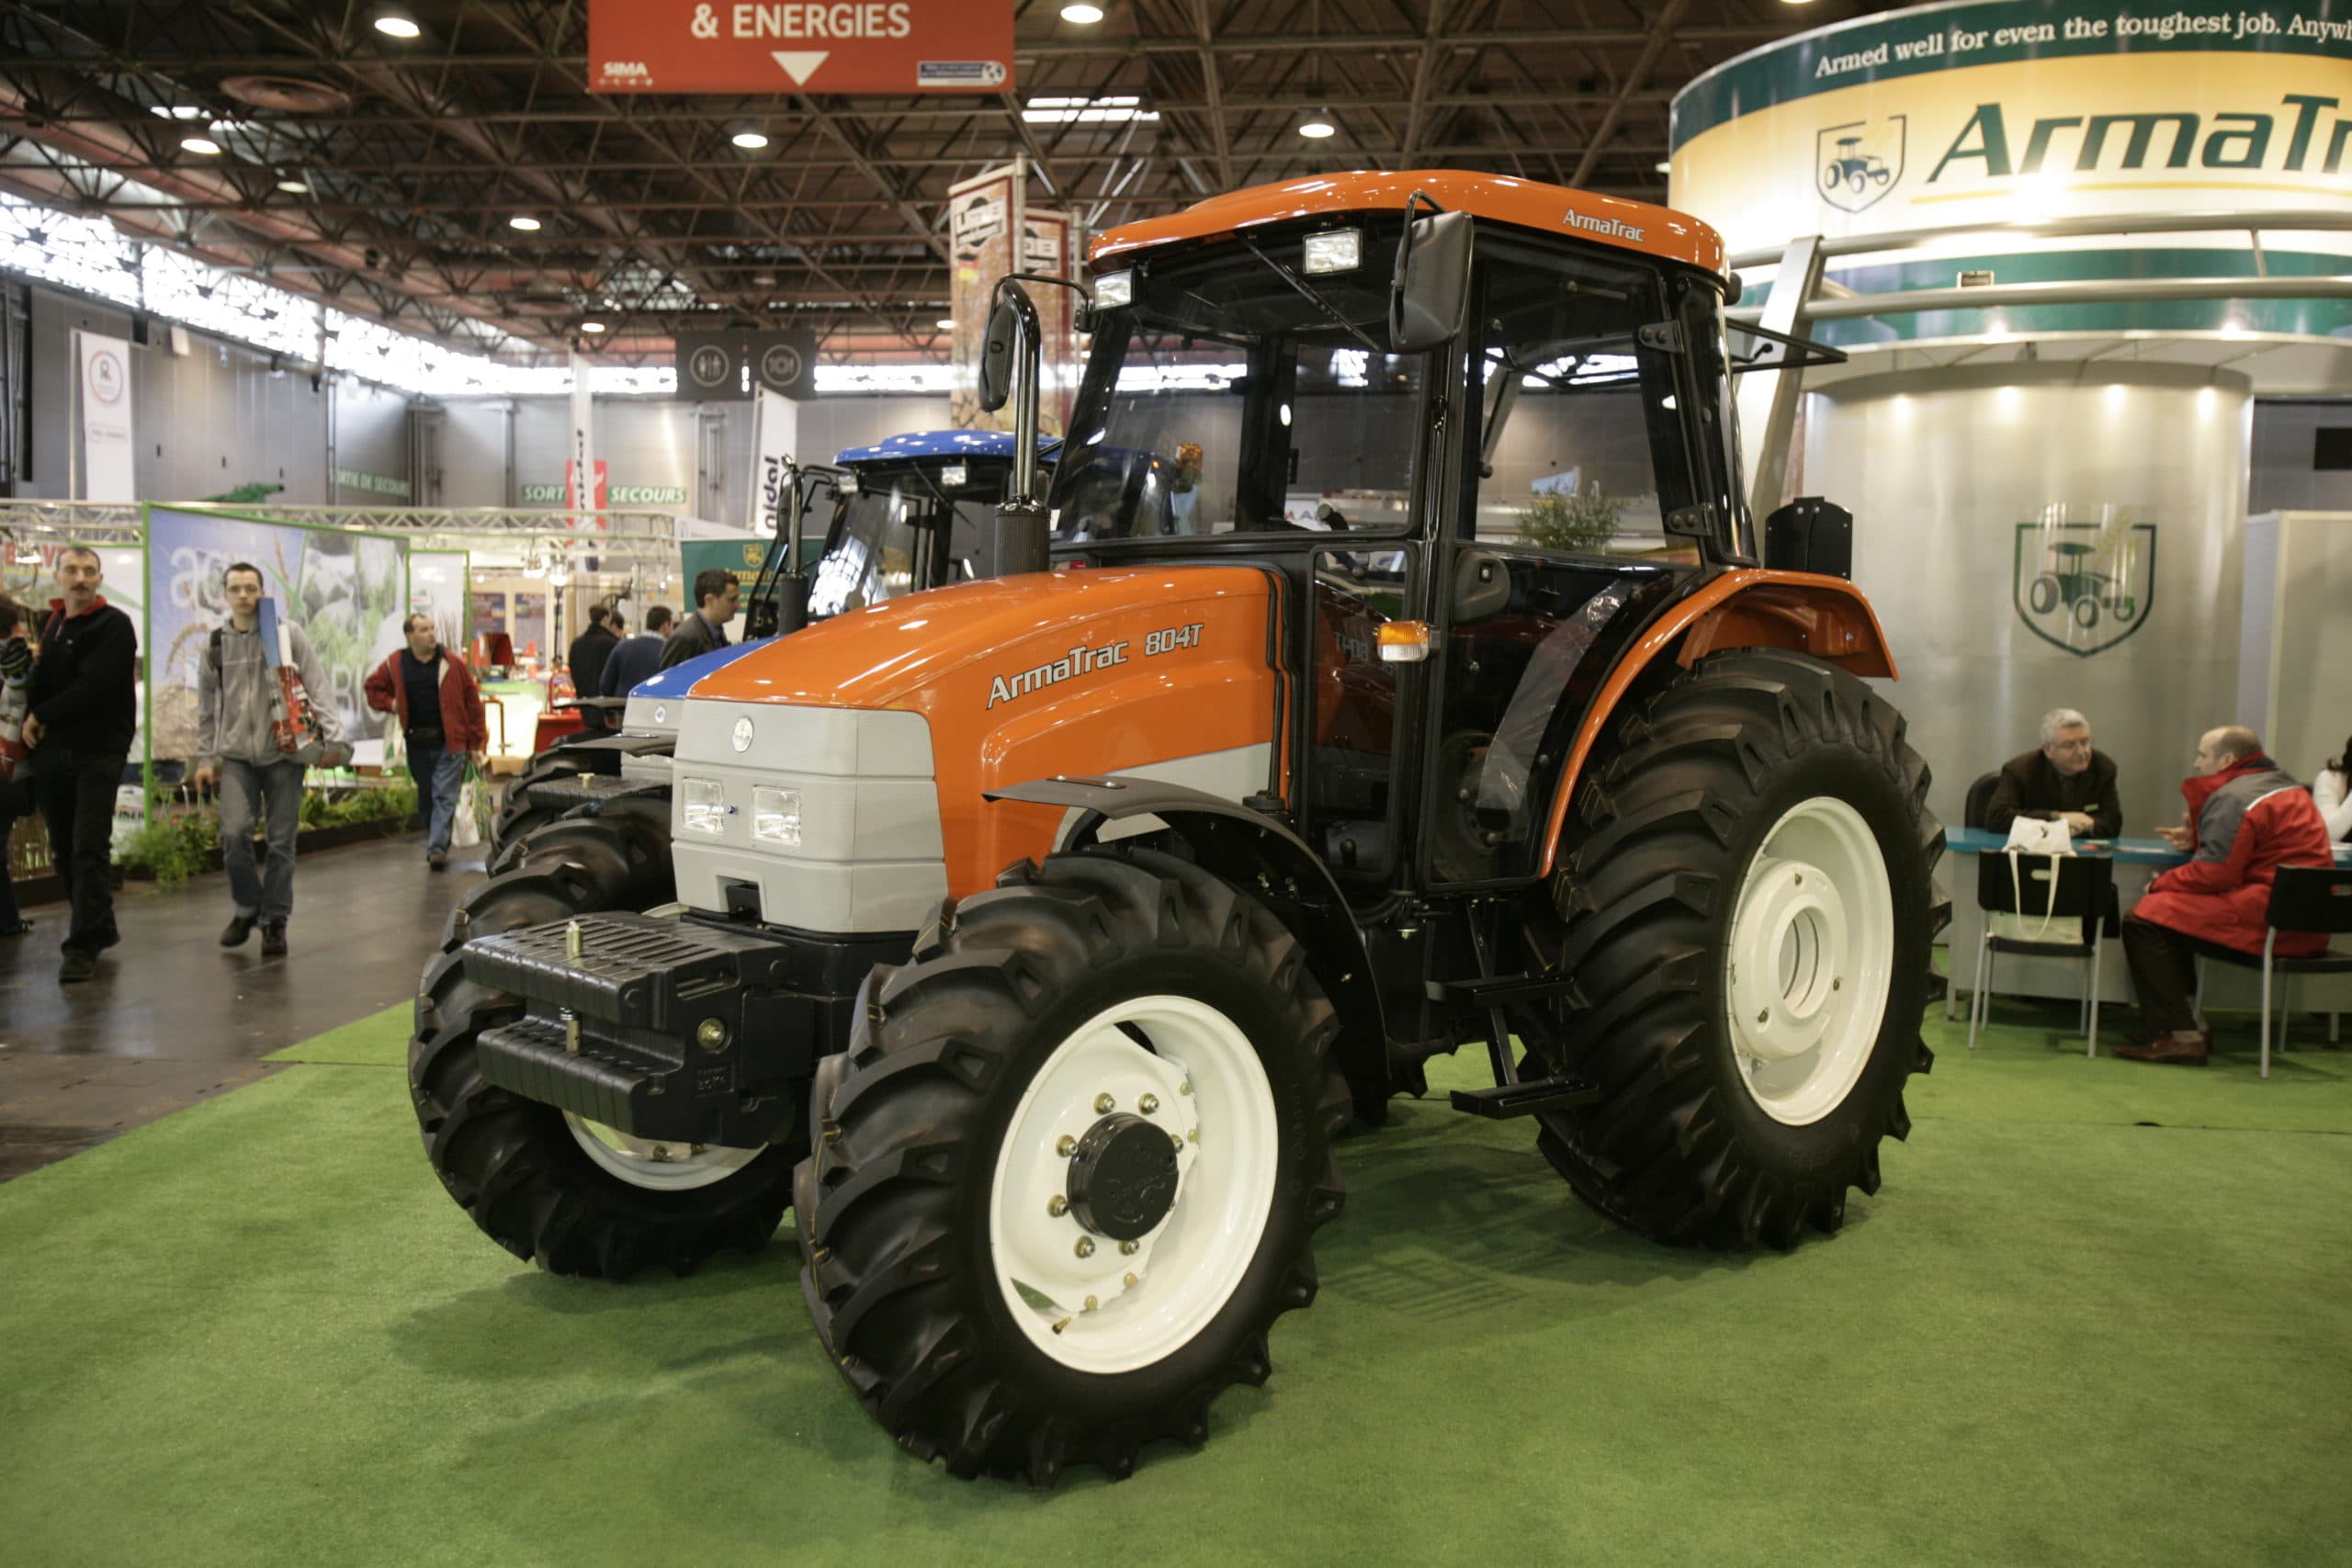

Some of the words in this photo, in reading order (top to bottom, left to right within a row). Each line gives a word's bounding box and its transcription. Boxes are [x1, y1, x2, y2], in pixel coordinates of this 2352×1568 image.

[691, 3, 719, 39] &
[733, 3, 910, 39] ENERGIES
[1815, 42, 1888, 79] Armed
[1894, 33, 1944, 61] well
[1951, 30, 1988, 52] for
[1993, 23, 2056, 46] even
[2064, 16, 2109, 39] the
[2116, 11, 2232, 40] toughest
[2233, 11, 2281, 40] job.
[603, 61, 648, 76] SIMA
[1562, 209, 1645, 243] ArmaTrac
[609, 487, 685, 503] SECOURS
[986, 640, 1129, 710] ArmaTrac
[1144, 623, 1204, 657] 804T
